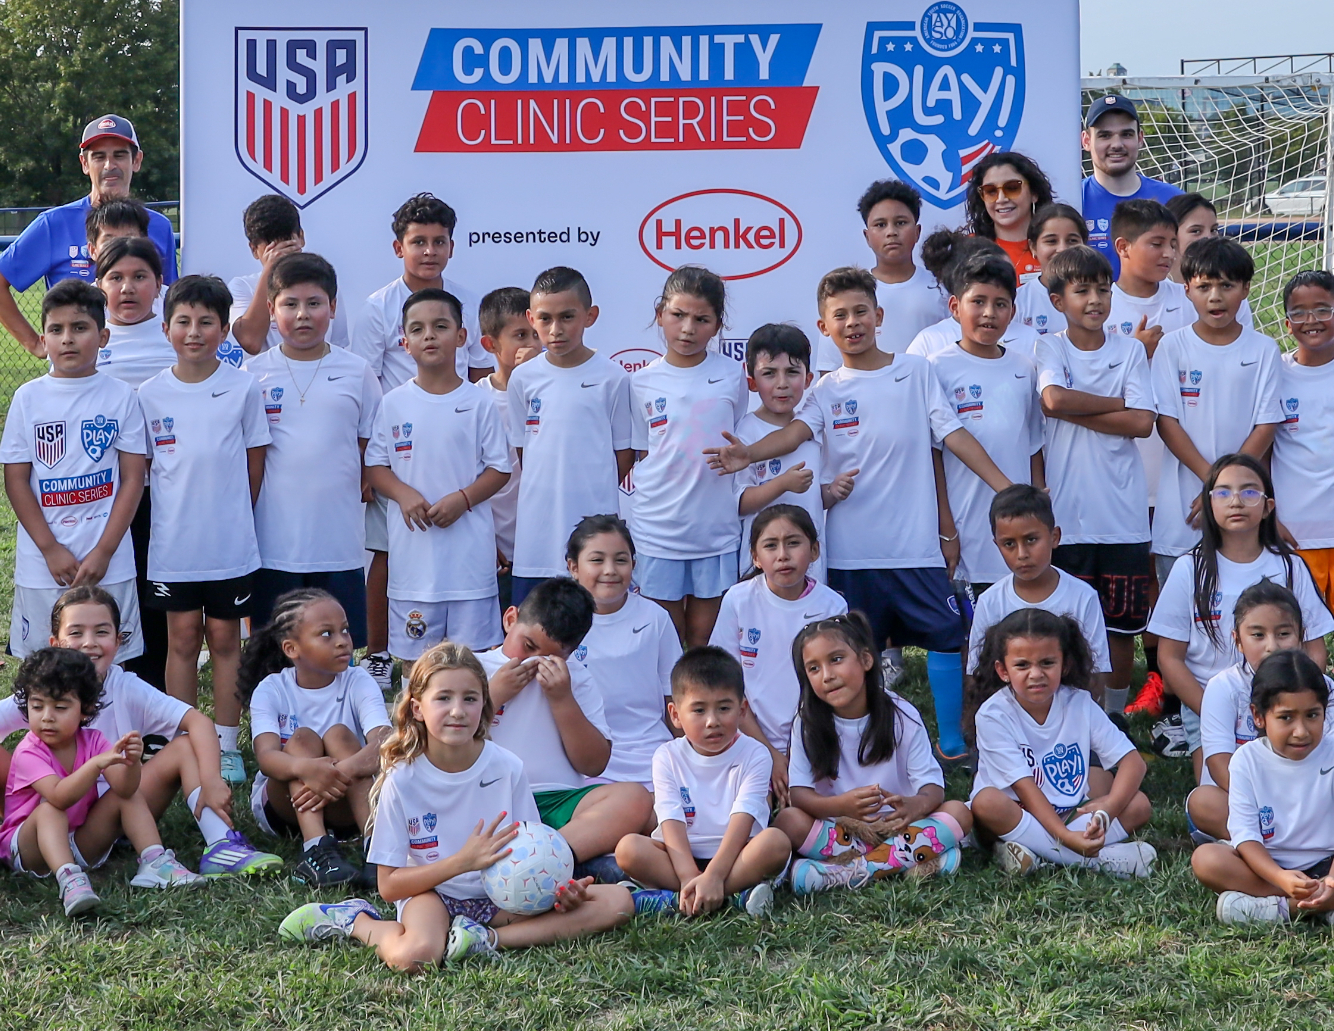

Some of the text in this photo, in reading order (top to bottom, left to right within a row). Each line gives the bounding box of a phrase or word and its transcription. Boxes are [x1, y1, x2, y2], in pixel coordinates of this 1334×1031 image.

[245, 38, 357, 104] USA
[452, 33, 781, 85] COMMUNITY
[872, 60, 1015, 138] PLAY!
[456, 94, 777, 146] CLINIC SERIES
[468, 227, 601, 247] presented by
[655, 217, 786, 251] Henkel
[722, 342, 749, 363] US
[37, 424, 63, 443] USA
[42, 471, 107, 492] COMMUNITY
[44, 485, 109, 506] CLINIC SERIES
[1045, 754, 1083, 784] PLAY!
